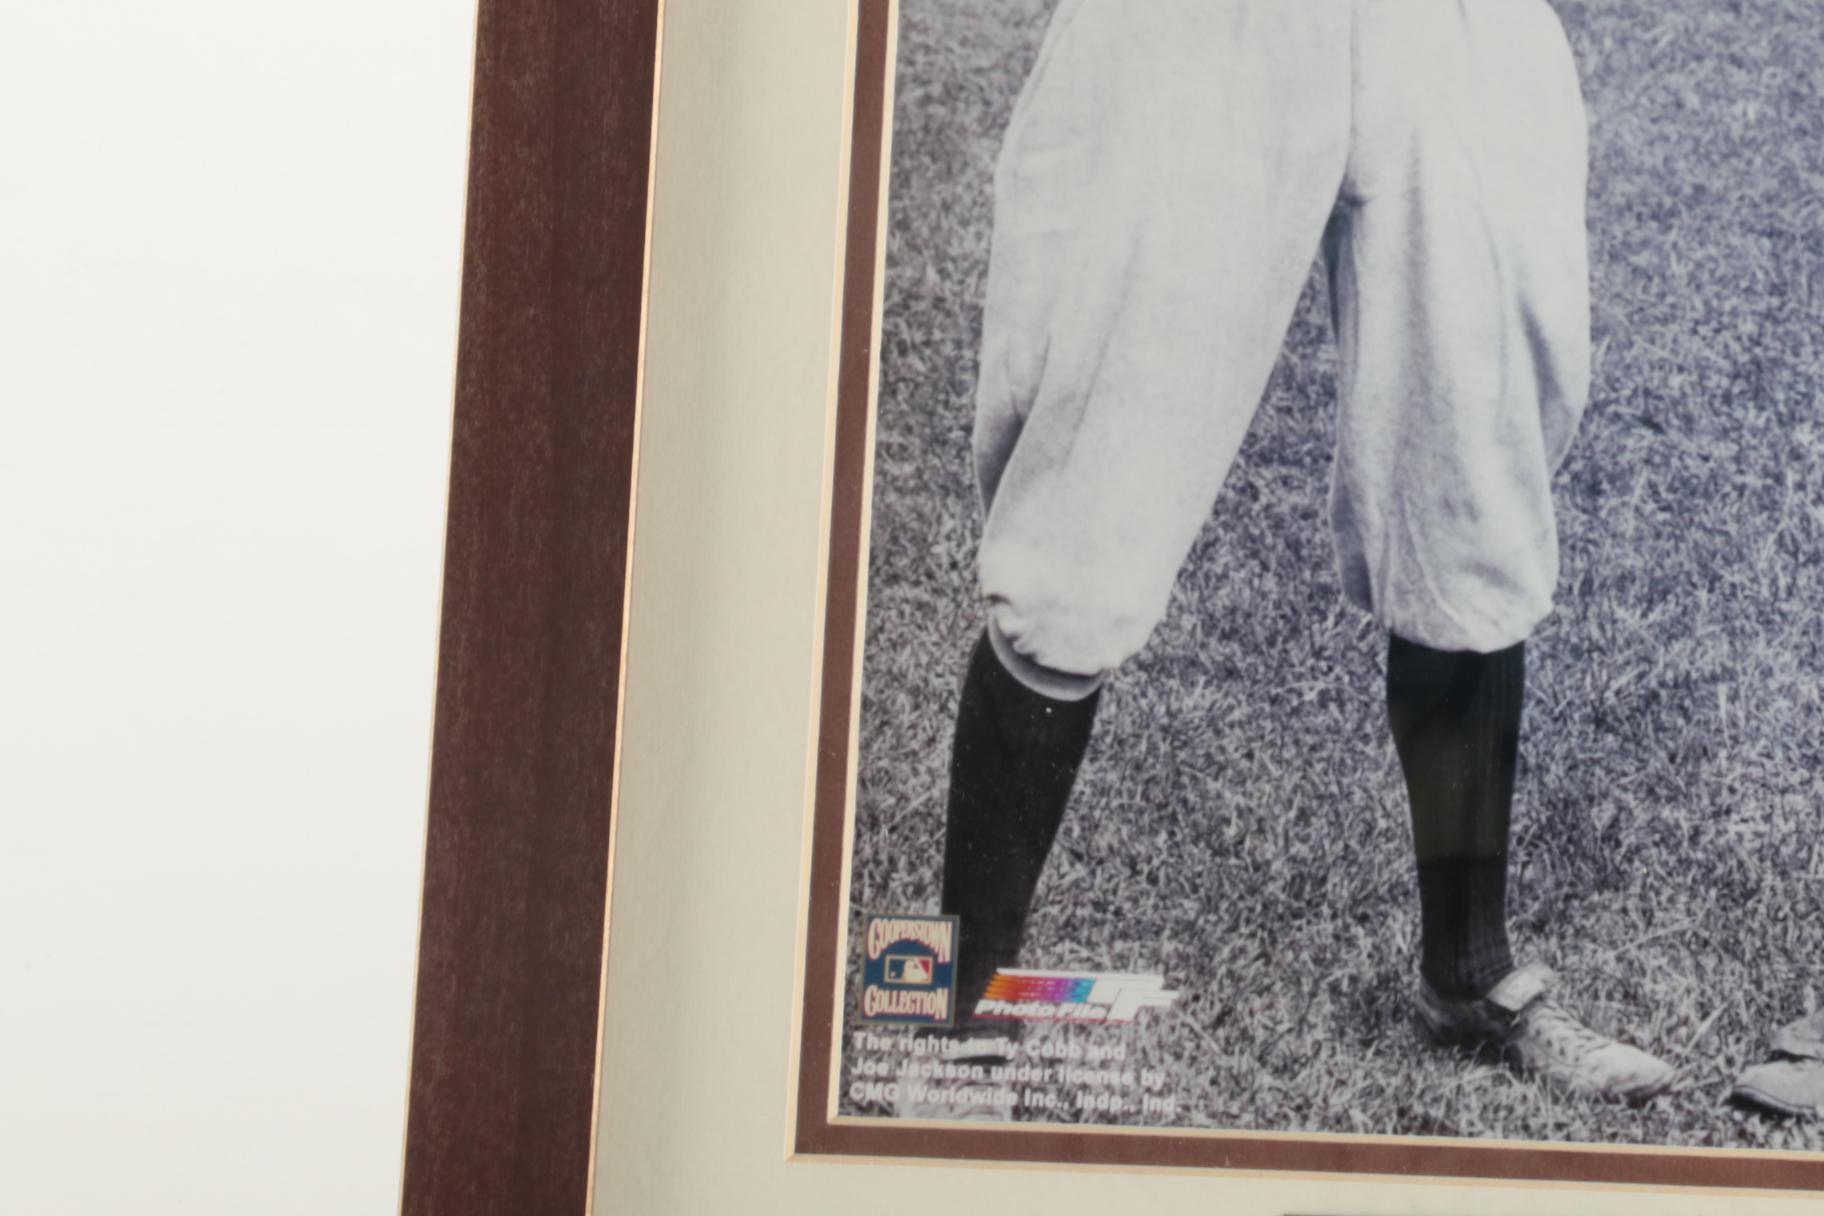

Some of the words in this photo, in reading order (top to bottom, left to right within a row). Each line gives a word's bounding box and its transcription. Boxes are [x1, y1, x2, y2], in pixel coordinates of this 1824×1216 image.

[868, 918, 952, 964] COOPERSTOWN
[864, 985, 948, 1020] COLLECTION
[974, 999, 1055, 1018] Photo
[1056, 1003, 1107, 1021] File
[853, 1031, 892, 1051] The
[899, 1034, 959, 1055] rights
[995, 1037, 1018, 1060] Ty
[1026, 1039, 1081, 1058] Cobb
[1087, 1043, 1127, 1061] and
[850, 1057, 889, 1077] Joe
[895, 1058, 984, 1079] Jackson
[991, 1063, 1054, 1082] under
[1058, 1065, 1136, 1086] license
[1141, 1068, 1166, 1091] by
[849, 1082, 900, 1101] CMG
[907, 1084, 1018, 1105] Worldwide
